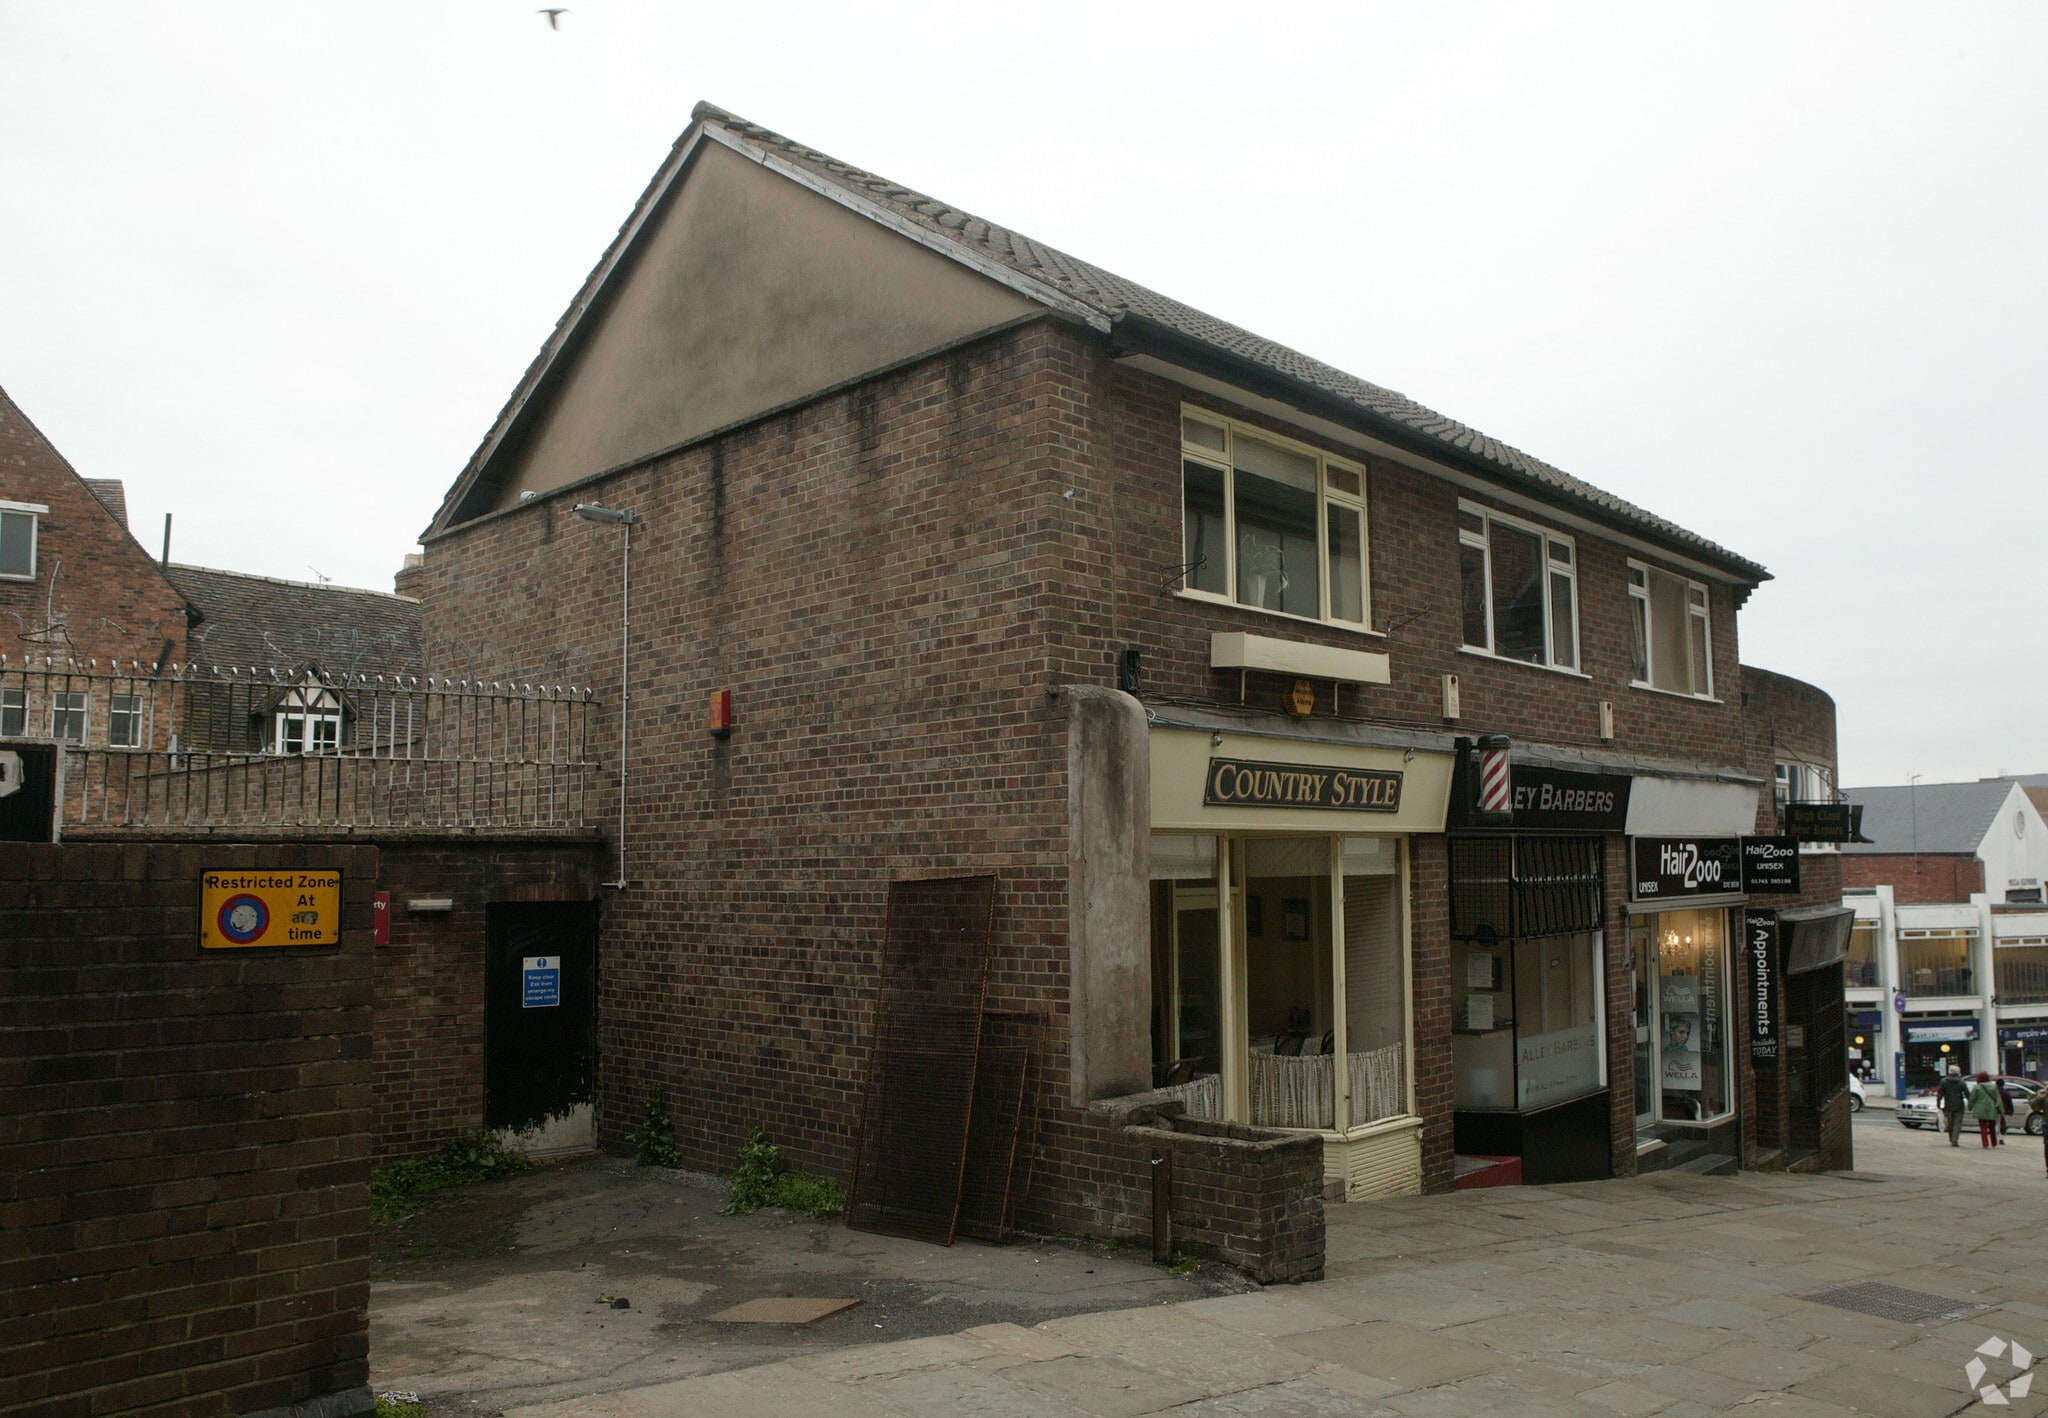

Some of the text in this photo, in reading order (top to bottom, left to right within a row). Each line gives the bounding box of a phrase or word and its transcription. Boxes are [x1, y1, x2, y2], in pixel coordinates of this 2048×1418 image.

[1214, 763, 1397, 807] COUNTRY STYLE
[1540, 783, 1614, 813] BARBERS
[1745, 844, 1794, 859] Hair2000
[1660, 843, 1721, 889] Hair2000
[1756, 862, 1784, 870] UNISEX
[208, 875, 335, 889] Restricted Zone
[1638, 881, 1659, 893] UNISEX
[297, 894, 315, 907] At
[288, 927, 322, 940] time
[1753, 929, 1770, 1036] Appointments
[1663, 995, 1695, 1003] WELLA
[1752, 1045, 1777, 1056] TODAY
[1664, 1071, 1698, 1079] WELLA
